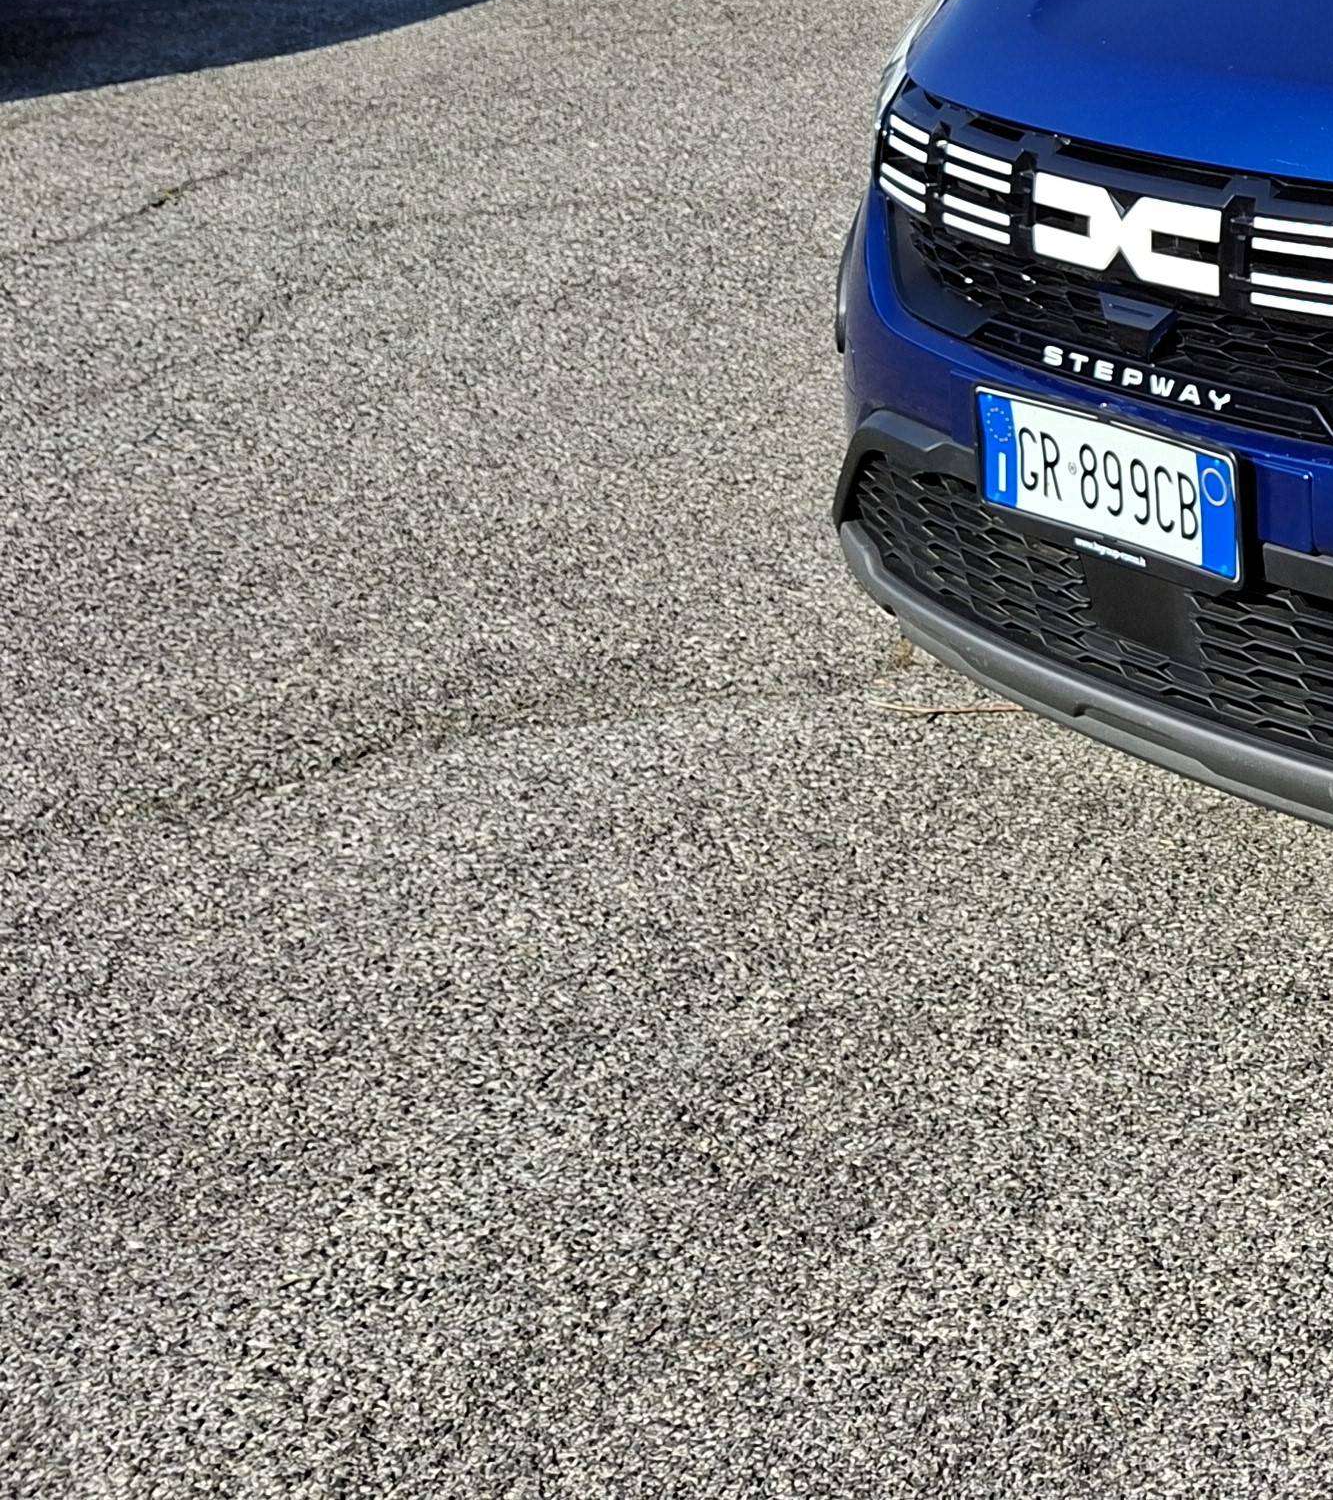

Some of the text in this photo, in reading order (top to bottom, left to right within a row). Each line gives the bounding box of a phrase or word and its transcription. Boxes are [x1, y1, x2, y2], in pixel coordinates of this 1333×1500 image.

[1042, 344, 1232, 411] STEPWAY
[1018, 426, 1062, 502] GR
[1078, 443, 1200, 540] 899CB
